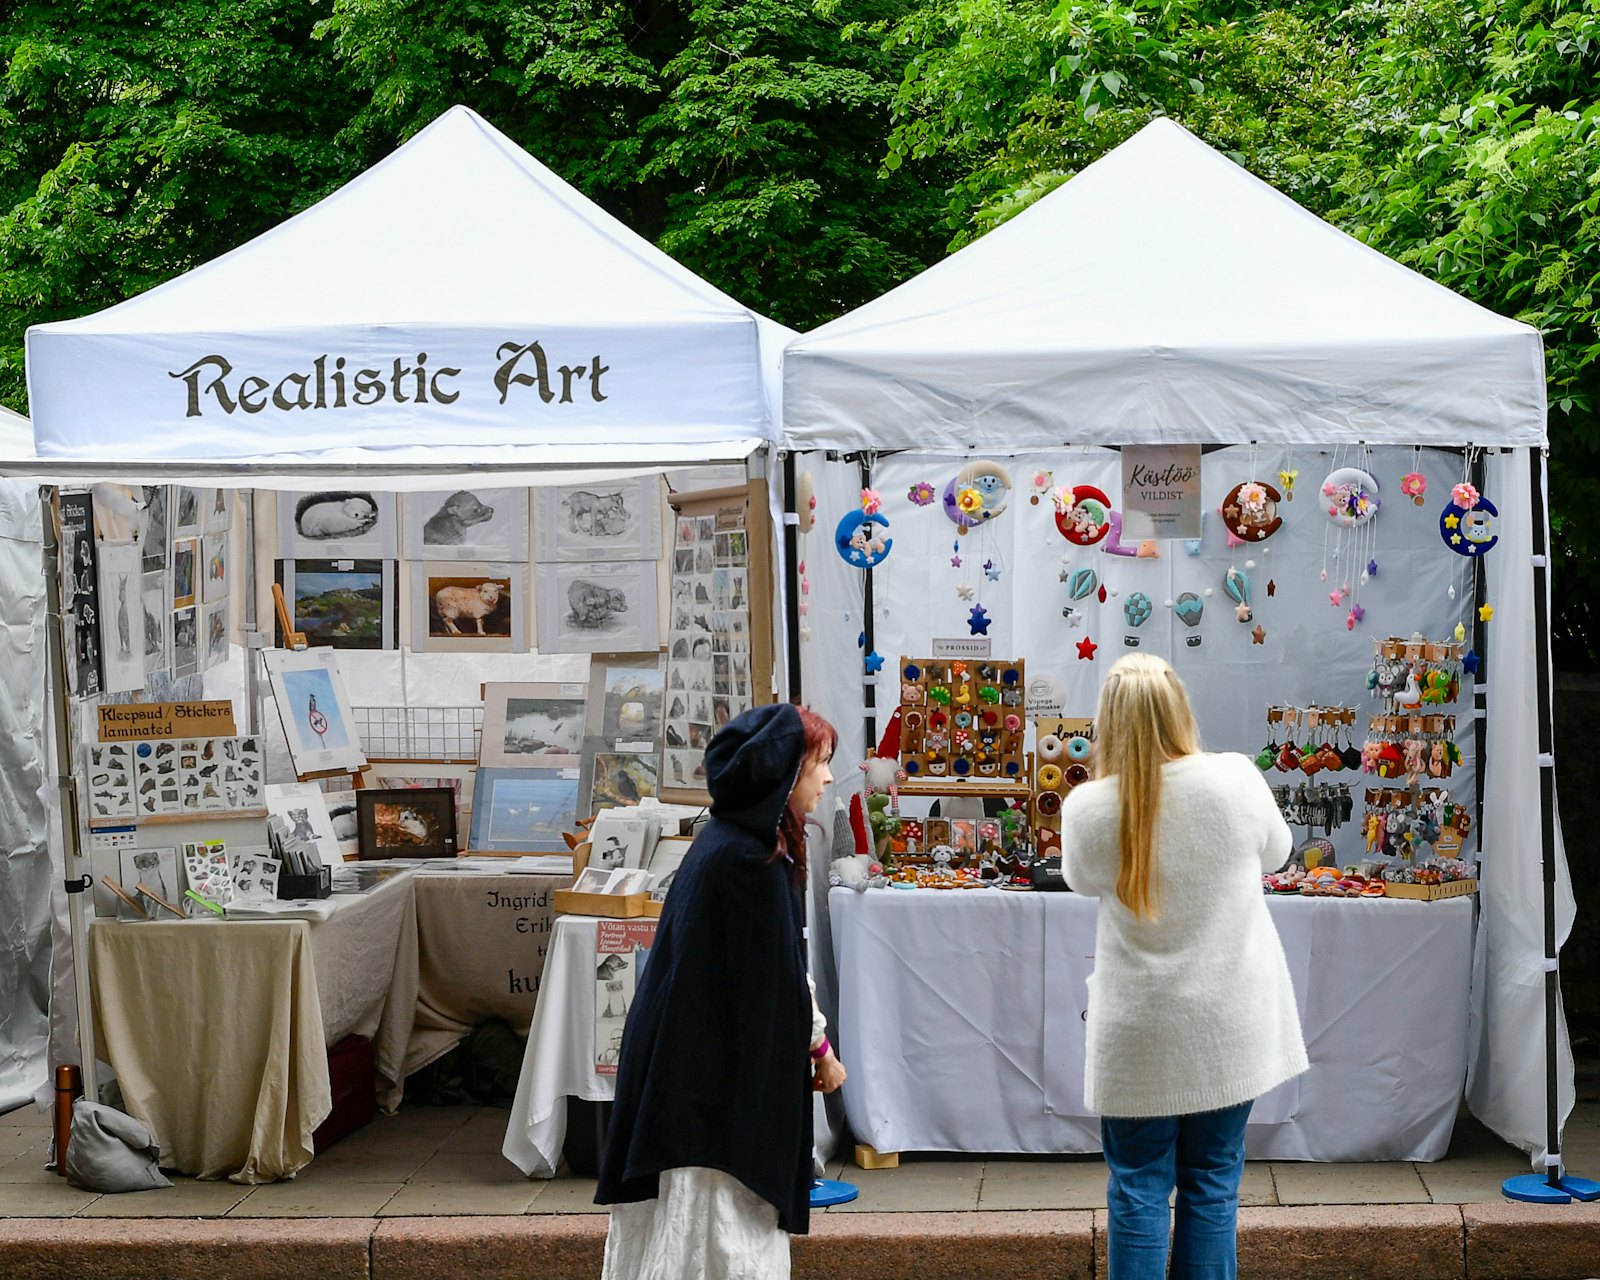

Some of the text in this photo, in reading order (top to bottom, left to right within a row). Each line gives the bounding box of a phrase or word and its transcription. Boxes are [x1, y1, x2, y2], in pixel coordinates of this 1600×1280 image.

[168, 339, 610, 418] Realistic Art
[1129, 463, 1194, 487] Käsitöö
[1140, 491, 1184, 501] VILDIST
[100, 706, 163, 724] Kleepsud
[175, 703, 231, 718] Stickers
[103, 721, 173, 738] laminated
[601, 922, 626, 931] Võtan
[627, 924, 649, 932] vastu
